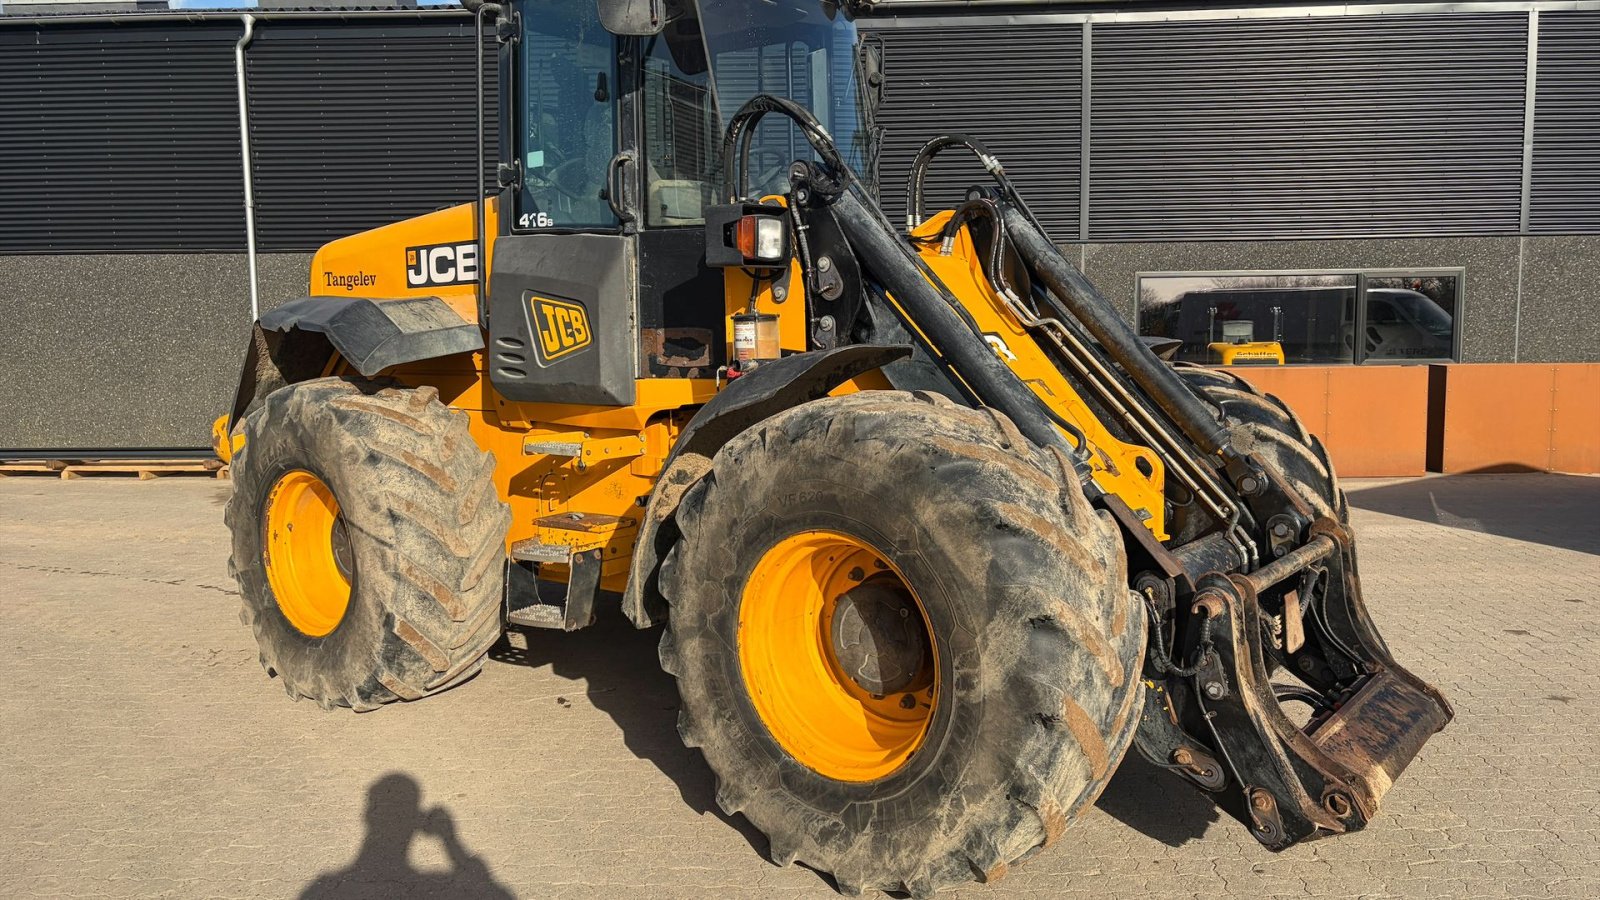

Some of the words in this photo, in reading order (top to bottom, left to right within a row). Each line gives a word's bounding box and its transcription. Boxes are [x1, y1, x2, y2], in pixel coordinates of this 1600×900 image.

[324, 271, 377, 290] Tangelev
[541, 303, 587, 353] JCB
[799, 490, 824, 505] 620
